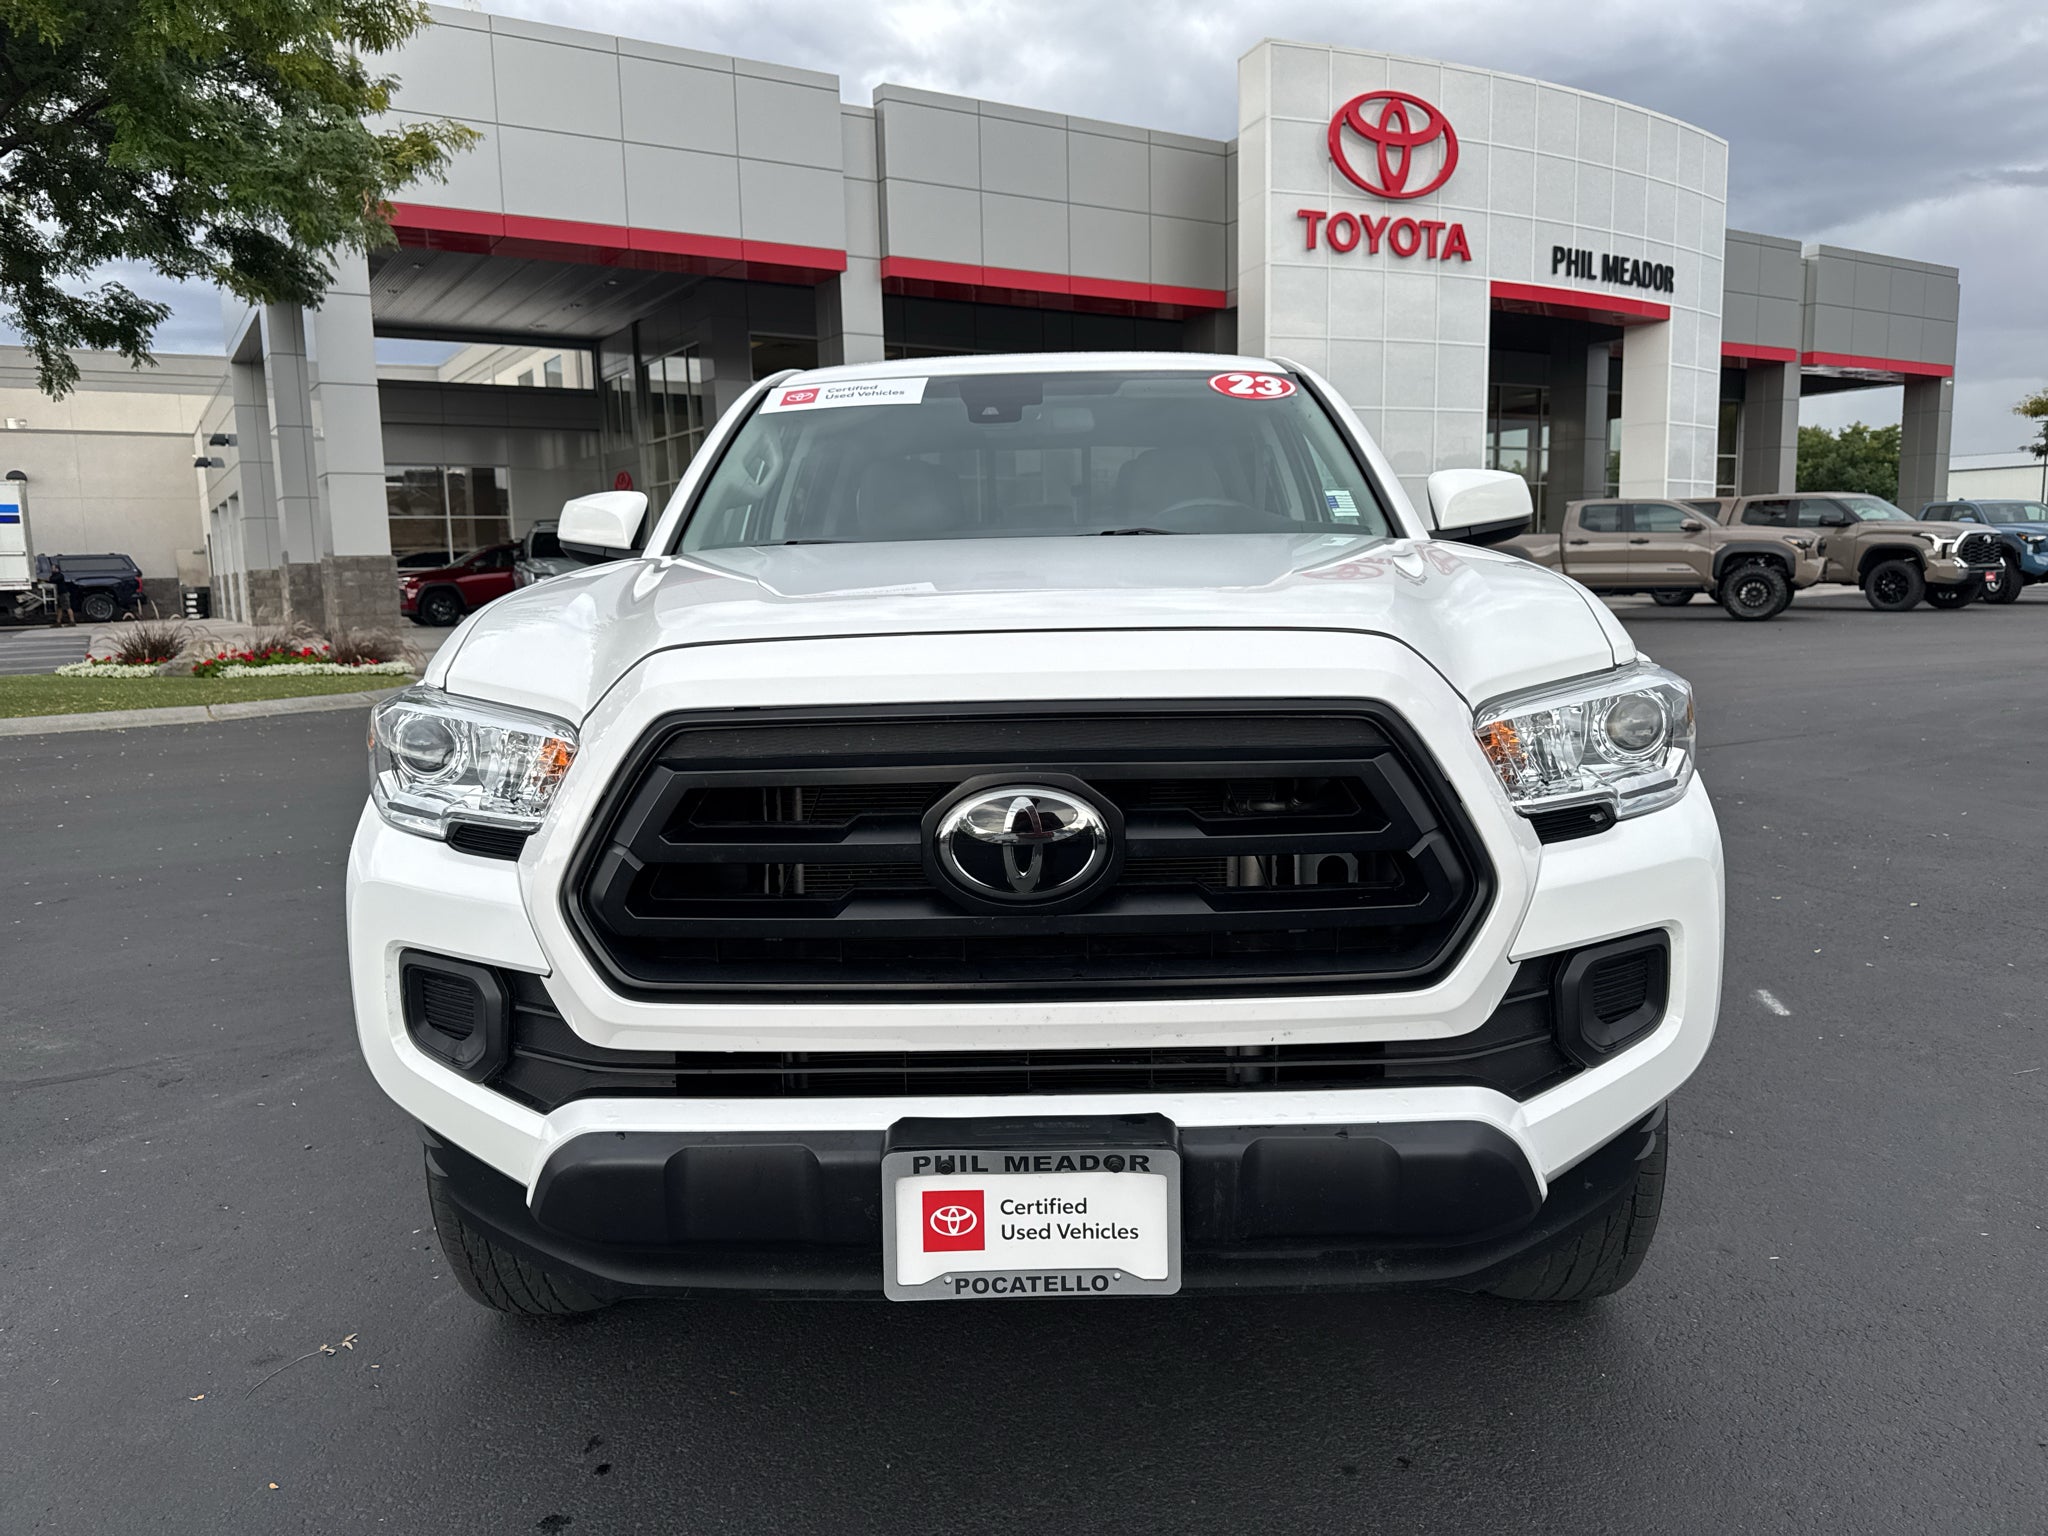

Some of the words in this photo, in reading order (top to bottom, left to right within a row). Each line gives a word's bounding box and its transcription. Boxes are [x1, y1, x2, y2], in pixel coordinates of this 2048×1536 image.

[1297, 209, 1472, 262] TOYOTA
[1551, 245, 1597, 280] PHIL
[1601, 253, 1674, 293] MEADOR
[825, 391, 854, 400] Used
[858, 389, 905, 397] Vehicles
[827, 384, 878, 393] Certified
[1227, 374, 1283, 396] 23
[912, 1154, 989, 1175] PHIL
[1003, 1154, 1151, 1173] MEADOR
[1000, 1197, 1088, 1215] Certified
[1001, 1223, 1051, 1240] Used
[1056, 1222, 1139, 1240] Vehicles
[954, 1274, 1109, 1295] POCATELLO
